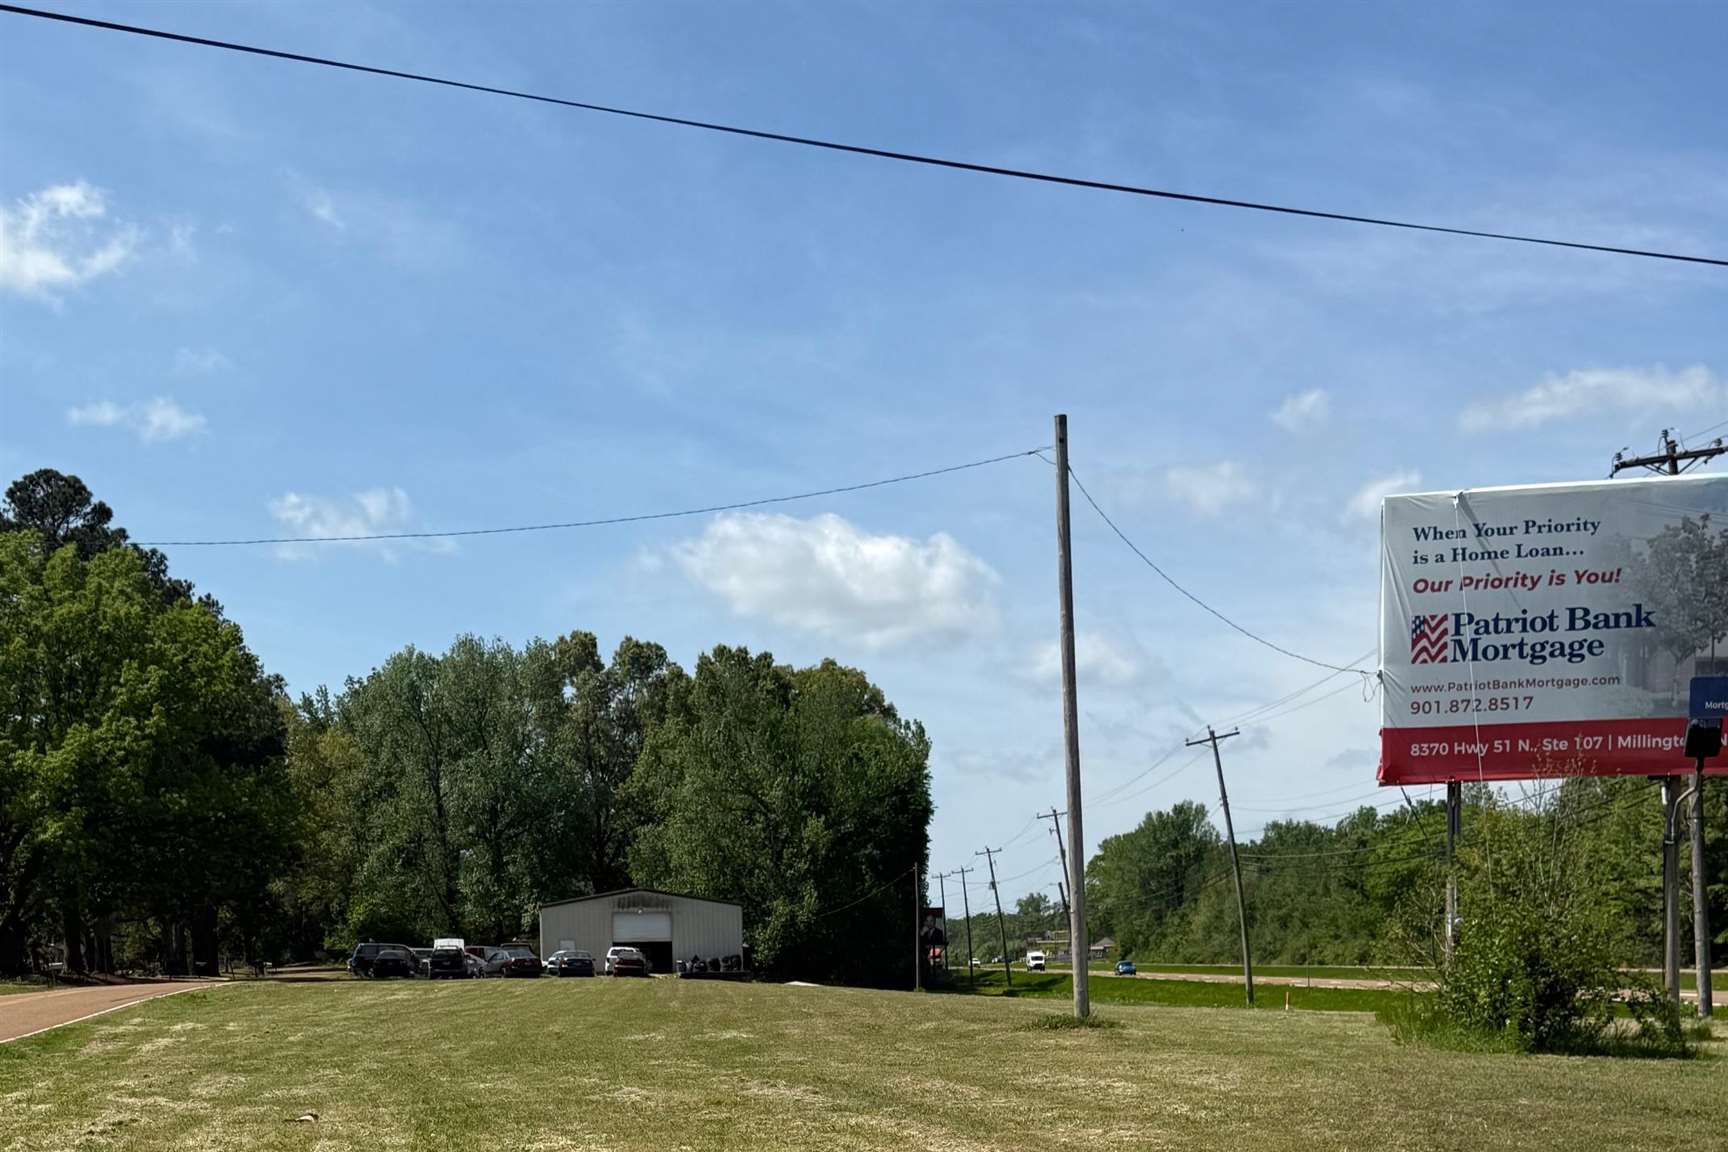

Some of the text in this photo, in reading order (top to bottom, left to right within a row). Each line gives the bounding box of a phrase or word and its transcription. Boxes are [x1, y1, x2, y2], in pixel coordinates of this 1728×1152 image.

[1412, 517, 1601, 542] When Your Priority
[1412, 543, 1584, 565] is a Home Loan...
[1412, 568, 1623, 594] Our Priority is You!
[1450, 603, 1657, 638] Patriot Bank
[1450, 637, 1605, 665] Mortgage
[1410, 675, 1621, 694] www.PatriotBankMortgage.com
[1410, 696, 1534, 715] 901.872.8517
[1410, 743, 1449, 756] 8370
[1453, 742, 1488, 756] Hwy
[1493, 740, 1511, 753] 51
[1542, 737, 1569, 750] Ste
[1574, 736, 1603, 750] 107
